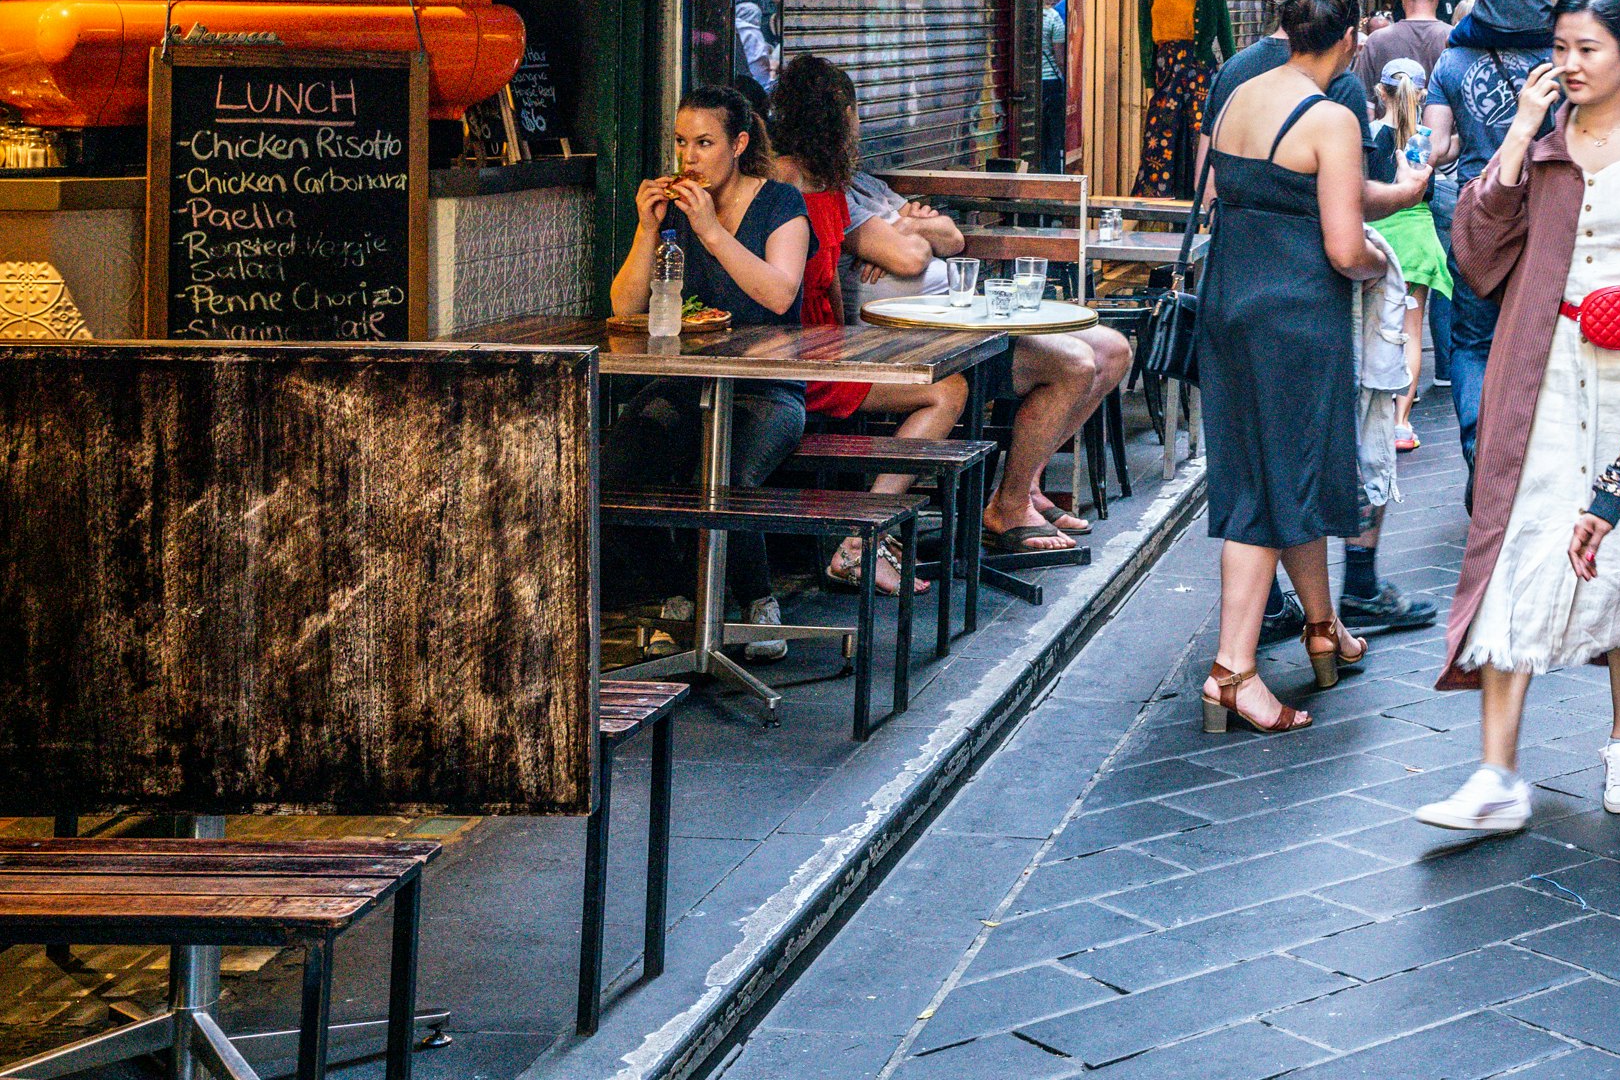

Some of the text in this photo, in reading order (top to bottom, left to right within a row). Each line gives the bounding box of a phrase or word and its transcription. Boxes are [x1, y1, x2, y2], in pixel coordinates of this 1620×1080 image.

[215, 74, 357, 116] LUNCH
[316, 126, 402, 161] Risotto
[293, 166, 407, 195] Carbonara
[292, 281, 405, 312] Chorizo
